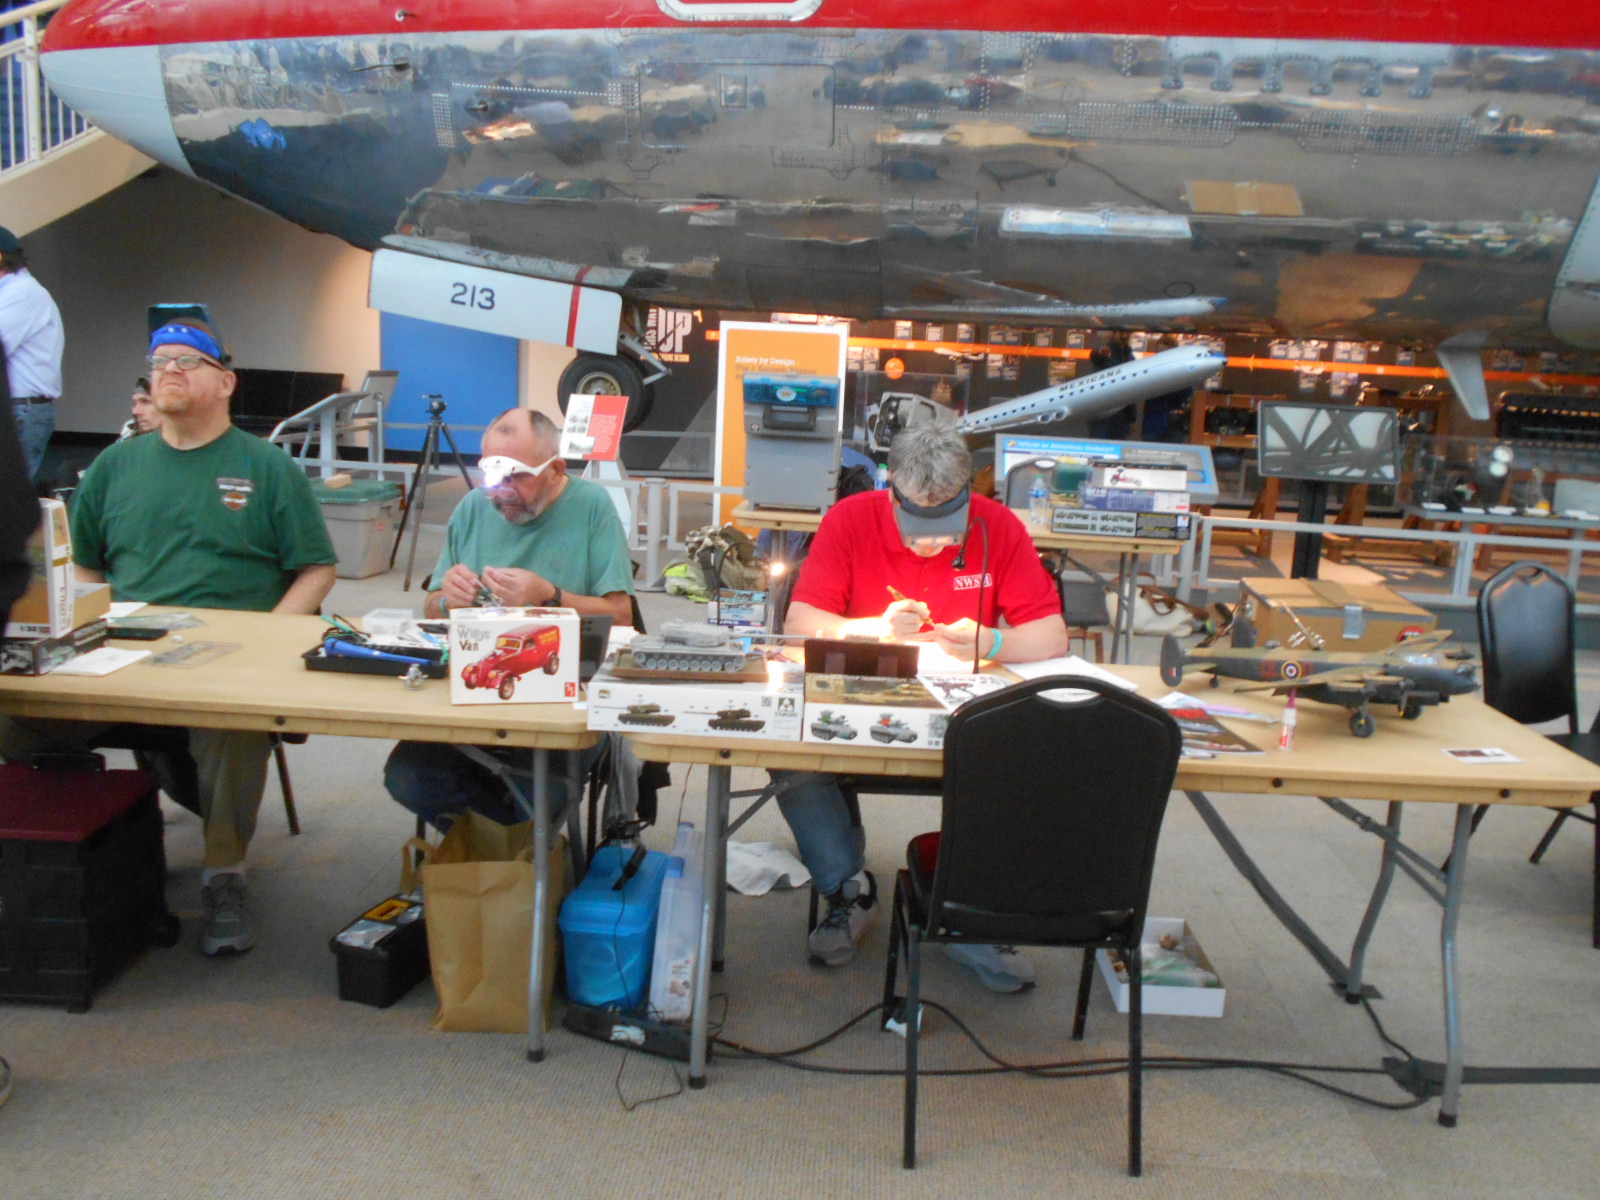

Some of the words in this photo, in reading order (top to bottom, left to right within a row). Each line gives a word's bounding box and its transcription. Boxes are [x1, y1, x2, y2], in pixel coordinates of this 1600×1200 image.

[450, 282, 495, 310] 213
[657, 307, 692, 353] UP
[735, 355, 758, 365] Safety
[759, 356, 769, 365] by
[770, 357, 796, 366] Design
[1059, 369, 1121, 392] MEXICANA
[457, 627, 490, 641] Willys
[459, 640, 479, 651] Van
